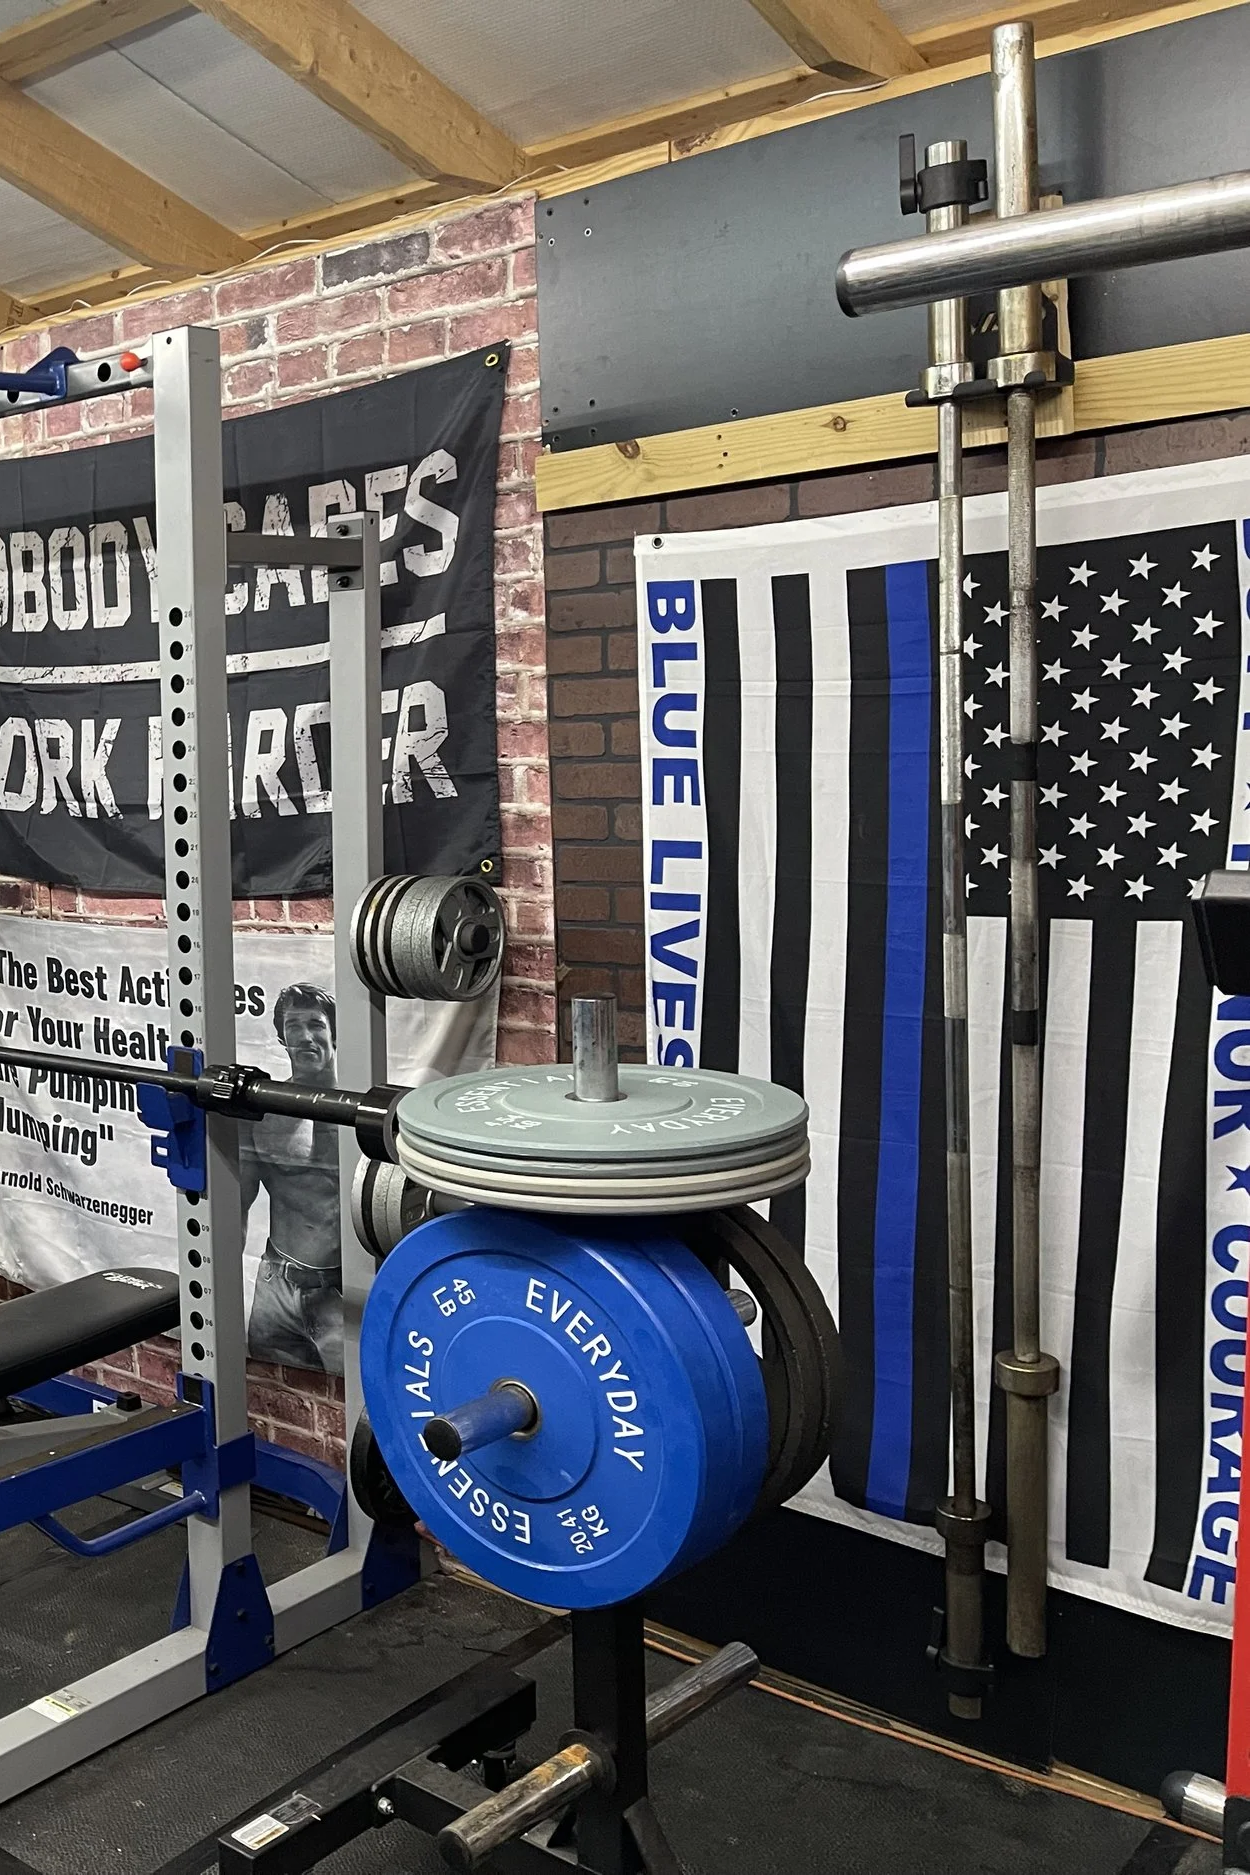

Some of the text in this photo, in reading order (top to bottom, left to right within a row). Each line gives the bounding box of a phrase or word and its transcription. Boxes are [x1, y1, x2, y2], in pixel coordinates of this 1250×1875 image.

[646, 579, 701, 806] BLUE
[46, 956, 108, 1002] Best
[27, 1005, 84, 1050] Your
[93, 1016, 170, 1063] Healt
[28, 1066, 142, 1118] Pumpin
[610, 1097, 747, 1135] EVERYDAY
[46, 1177, 154, 1226] Schwarzenegger
[432, 1286, 457, 1317] LB
[453, 1279, 476, 1305] 45
[525, 1277, 645, 1472] EVERYDAY
[556, 1508, 594, 1554] 20.41
[581, 1505, 610, 1537] KG
